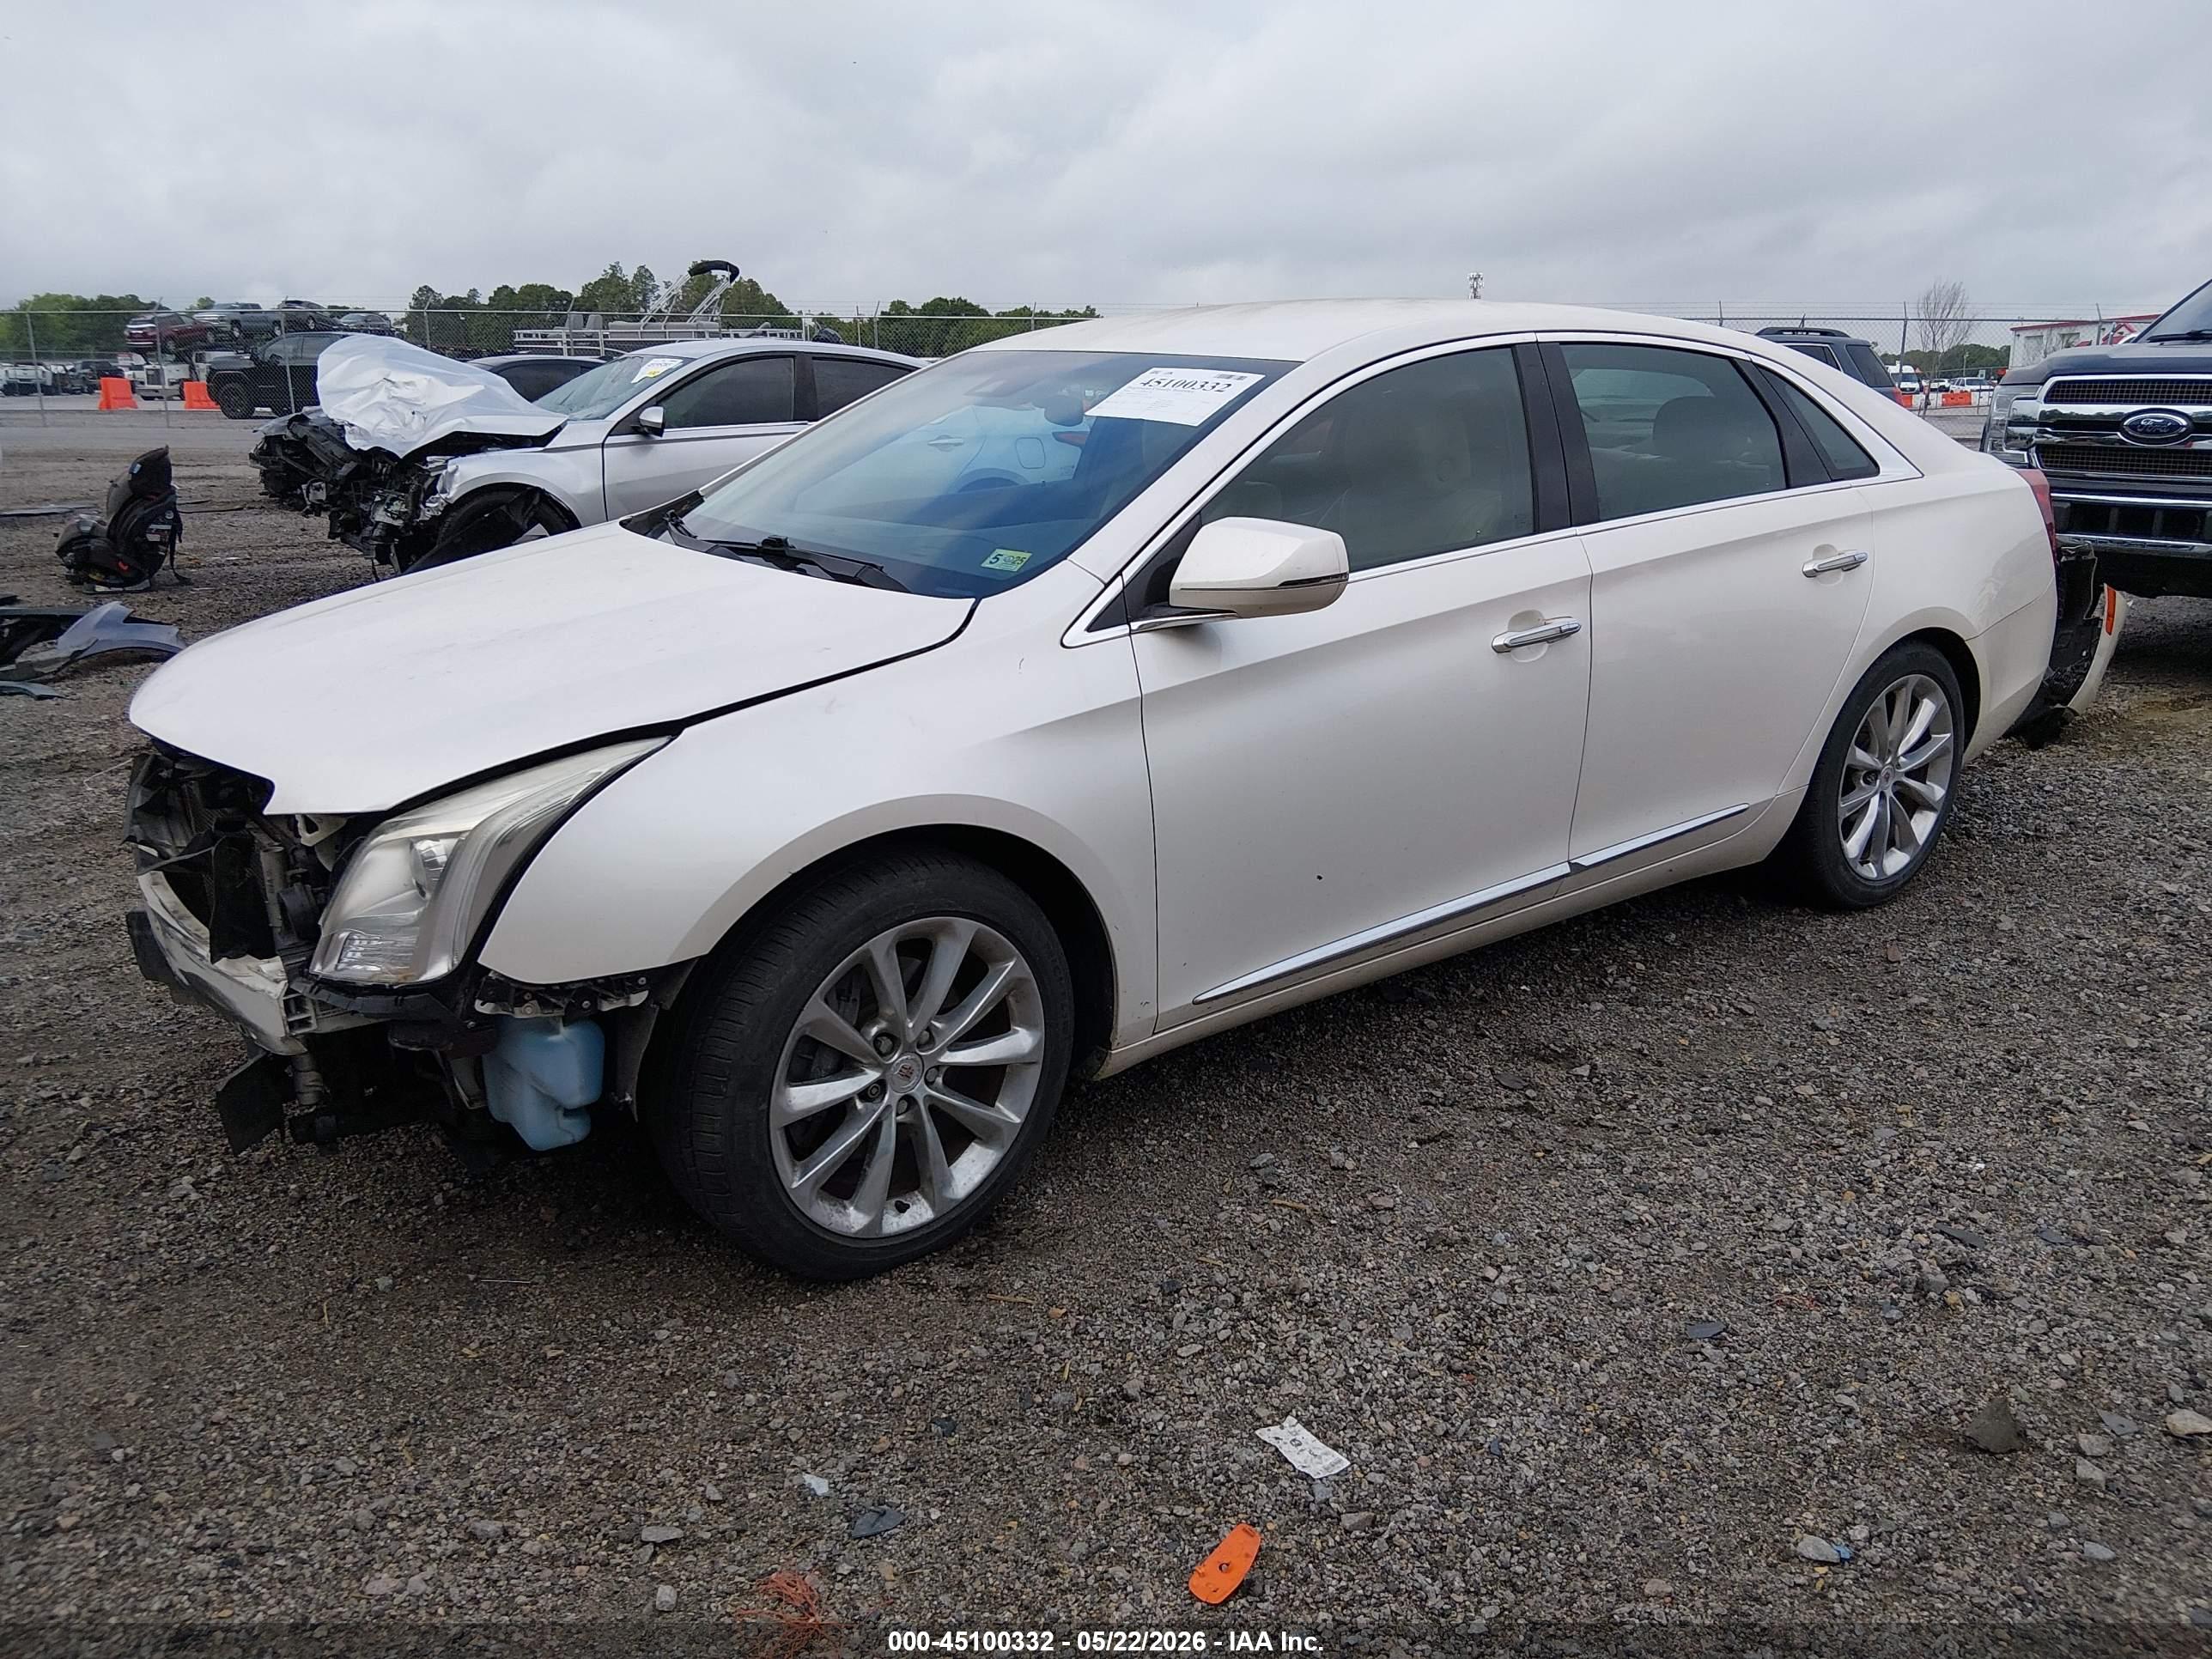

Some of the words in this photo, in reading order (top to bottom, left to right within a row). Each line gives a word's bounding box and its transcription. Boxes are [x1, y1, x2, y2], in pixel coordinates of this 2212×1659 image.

[1140, 378, 1232, 392] 45100332
[2136, 417, 2172, 433] Ford
[989, 554, 1003, 564] 5
